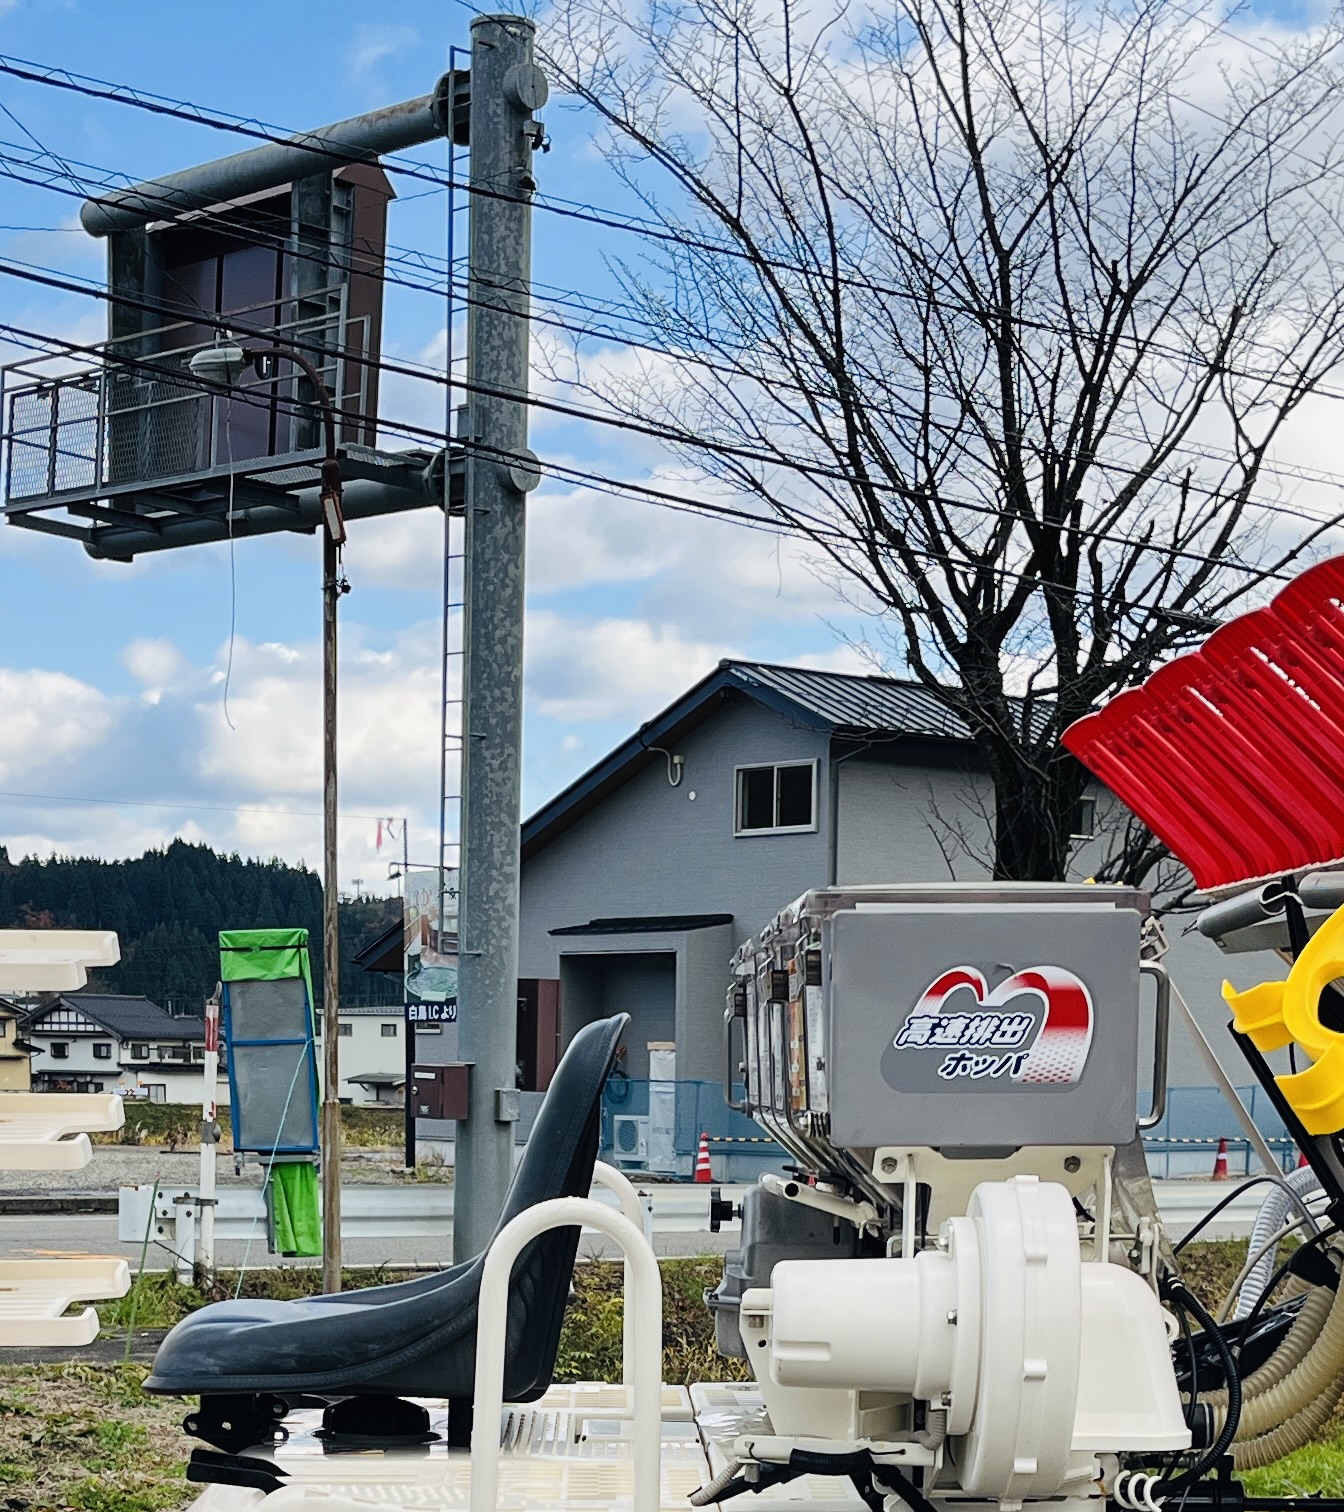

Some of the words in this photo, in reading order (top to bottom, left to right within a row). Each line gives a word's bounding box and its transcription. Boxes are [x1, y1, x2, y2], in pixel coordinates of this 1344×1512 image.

[895, 1014, 1033, 1047] 高速排出
[939, 1051, 1030, 1077] ホッパ
